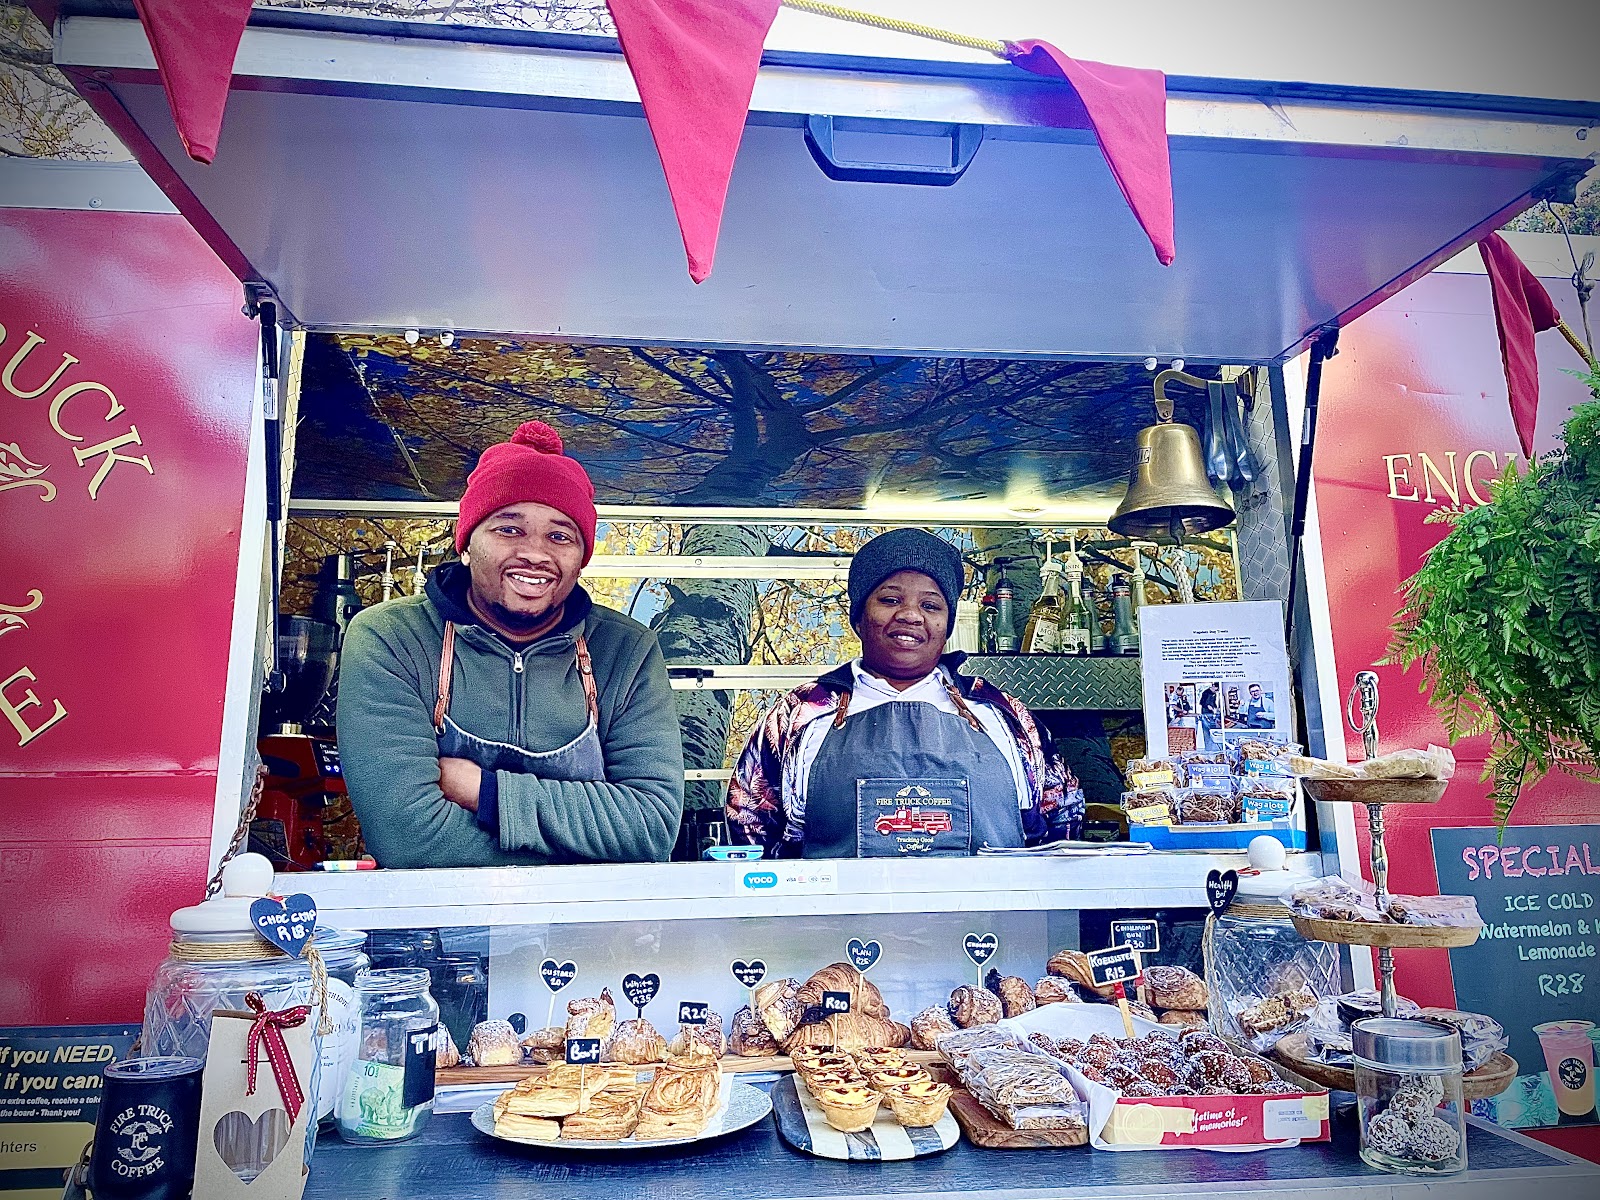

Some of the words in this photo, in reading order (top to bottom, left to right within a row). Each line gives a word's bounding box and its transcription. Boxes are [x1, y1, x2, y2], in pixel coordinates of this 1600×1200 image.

[0, 322, 155, 501] UCK
[876, 798, 893, 806] FIRE
[922, 798, 952, 806] COFFEE
[747, 875, 774, 884] YOCO
[1504, 894, 1541, 912] ICE
[1547, 892, 1594, 911] COLD
[258, 912, 290, 927] CHOC
[1480, 920, 1572, 940] Watermelon
[1577, 919, 1591, 934] &
[1518, 941, 1597, 961] Lemonade
[625, 979, 654, 990] White
[1538, 973, 1586, 997] R28
[825, 996, 848, 1010] R20
[681, 1006, 708, 1020] R20
[11, 1050, 50, 1068] you
[53, 1045, 117, 1064] NEED,
[364, 1065, 376, 1077] 10
[4, 1073, 20, 1089] if
[20, 1076, 58, 1094] you
[7, 1097, 26, 1105] extra
[52, 1096, 78, 1105] receive
[0, 1109, 13, 1117] the
[13, 1108, 35, 1117] board
[40, 1108, 63, 1117] Thank
[63, 1109, 81, 1118] you!
[110, 1107, 136, 1134] FIRE
[138, 1104, 175, 1134] TRUCK
[1224, 1107, 1236, 1119] of
[110, 1156, 165, 1178] COFFEE
